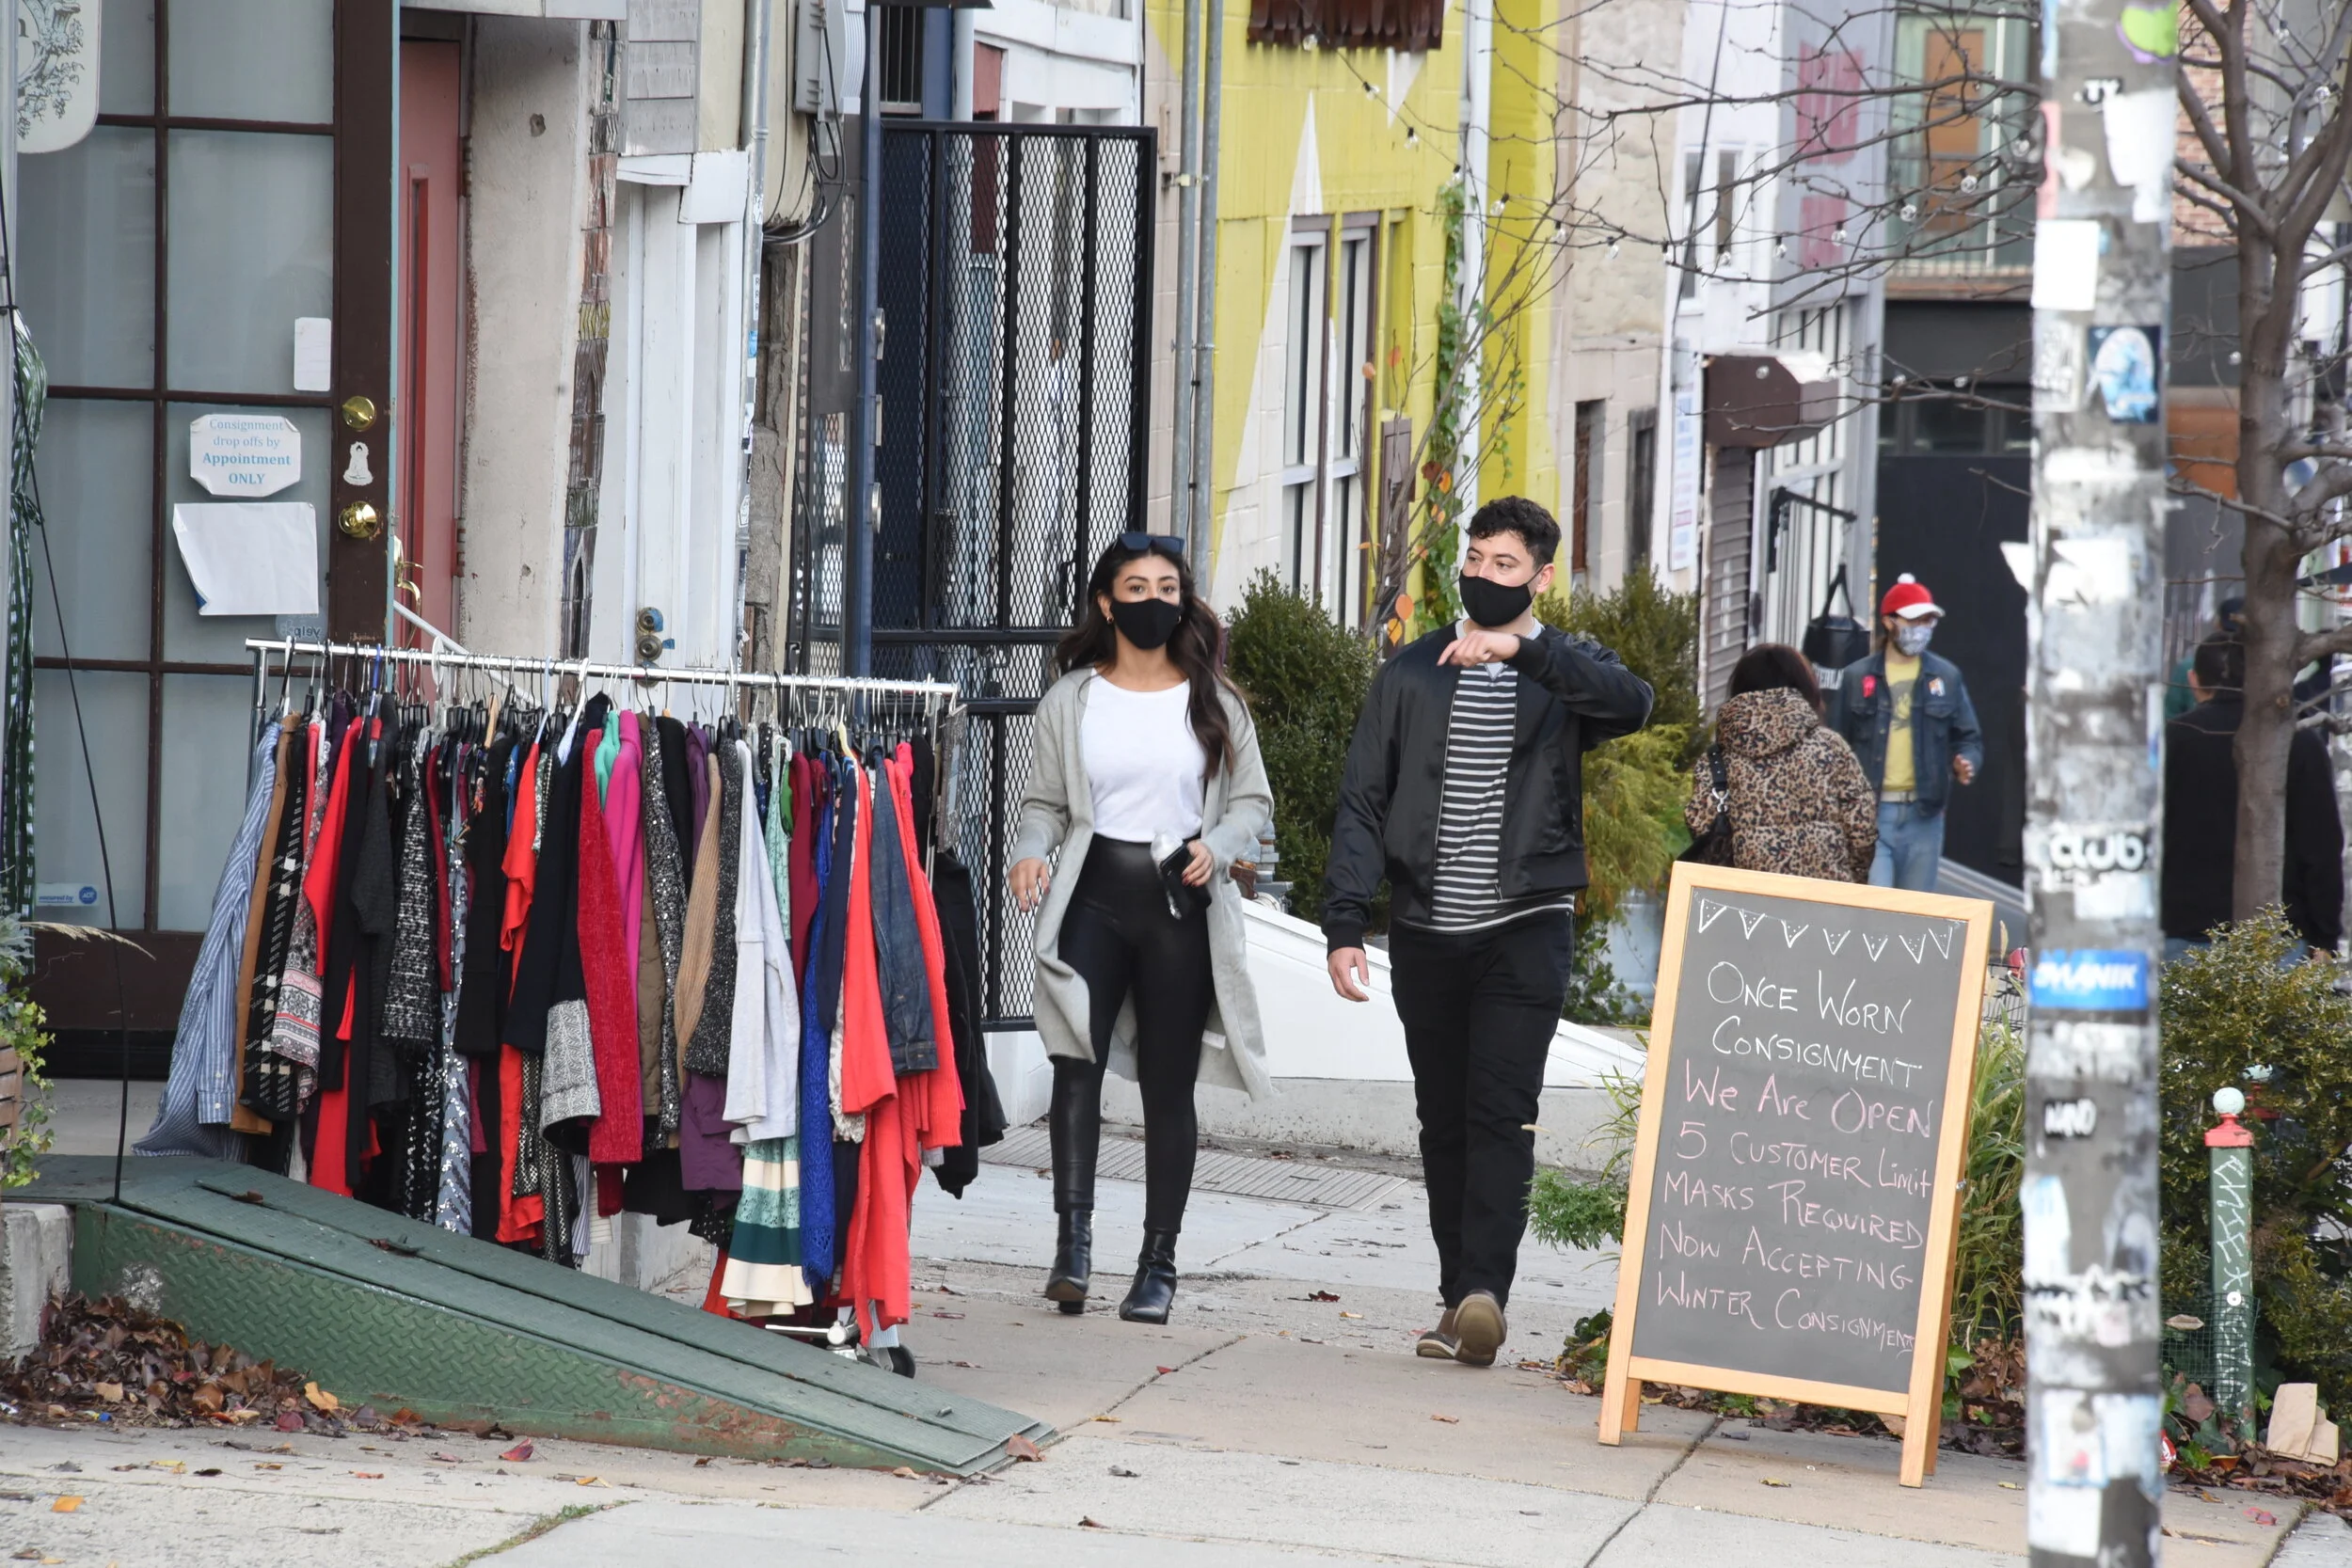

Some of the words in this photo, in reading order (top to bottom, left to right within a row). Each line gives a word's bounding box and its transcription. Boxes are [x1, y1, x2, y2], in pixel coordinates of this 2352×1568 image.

[202, 451, 291, 467] Appointment
[209, 419, 284, 432] Consignment
[213, 436, 240, 448] drop
[243, 436, 263, 447] offs
[266, 436, 280, 450] by
[229, 473, 265, 484] ONLY
[1708, 961, 1798, 1012] ONCE
[1819, 969, 1912, 1034] WORN
[1712, 1015, 1923, 1088] CONSIGNMENT
[1686, 1058, 1739, 1112] We
[1757, 1073, 1811, 1120] Are
[1831, 1086, 1933, 1138] OPEN
[1677, 1121, 1707, 1159] 5
[1730, 1132, 1872, 1187] CUSTOMER
[1664, 1171, 1755, 1210] MASKS
[1768, 1180, 1923, 1249] REQUIRED
[1661, 1220, 1721, 1259] NOW
[1742, 1226, 1914, 1290] ACCEPTING
[1658, 1271, 1765, 1329] WINTER
[1775, 1288, 1915, 1355] CONSIGNMENT
